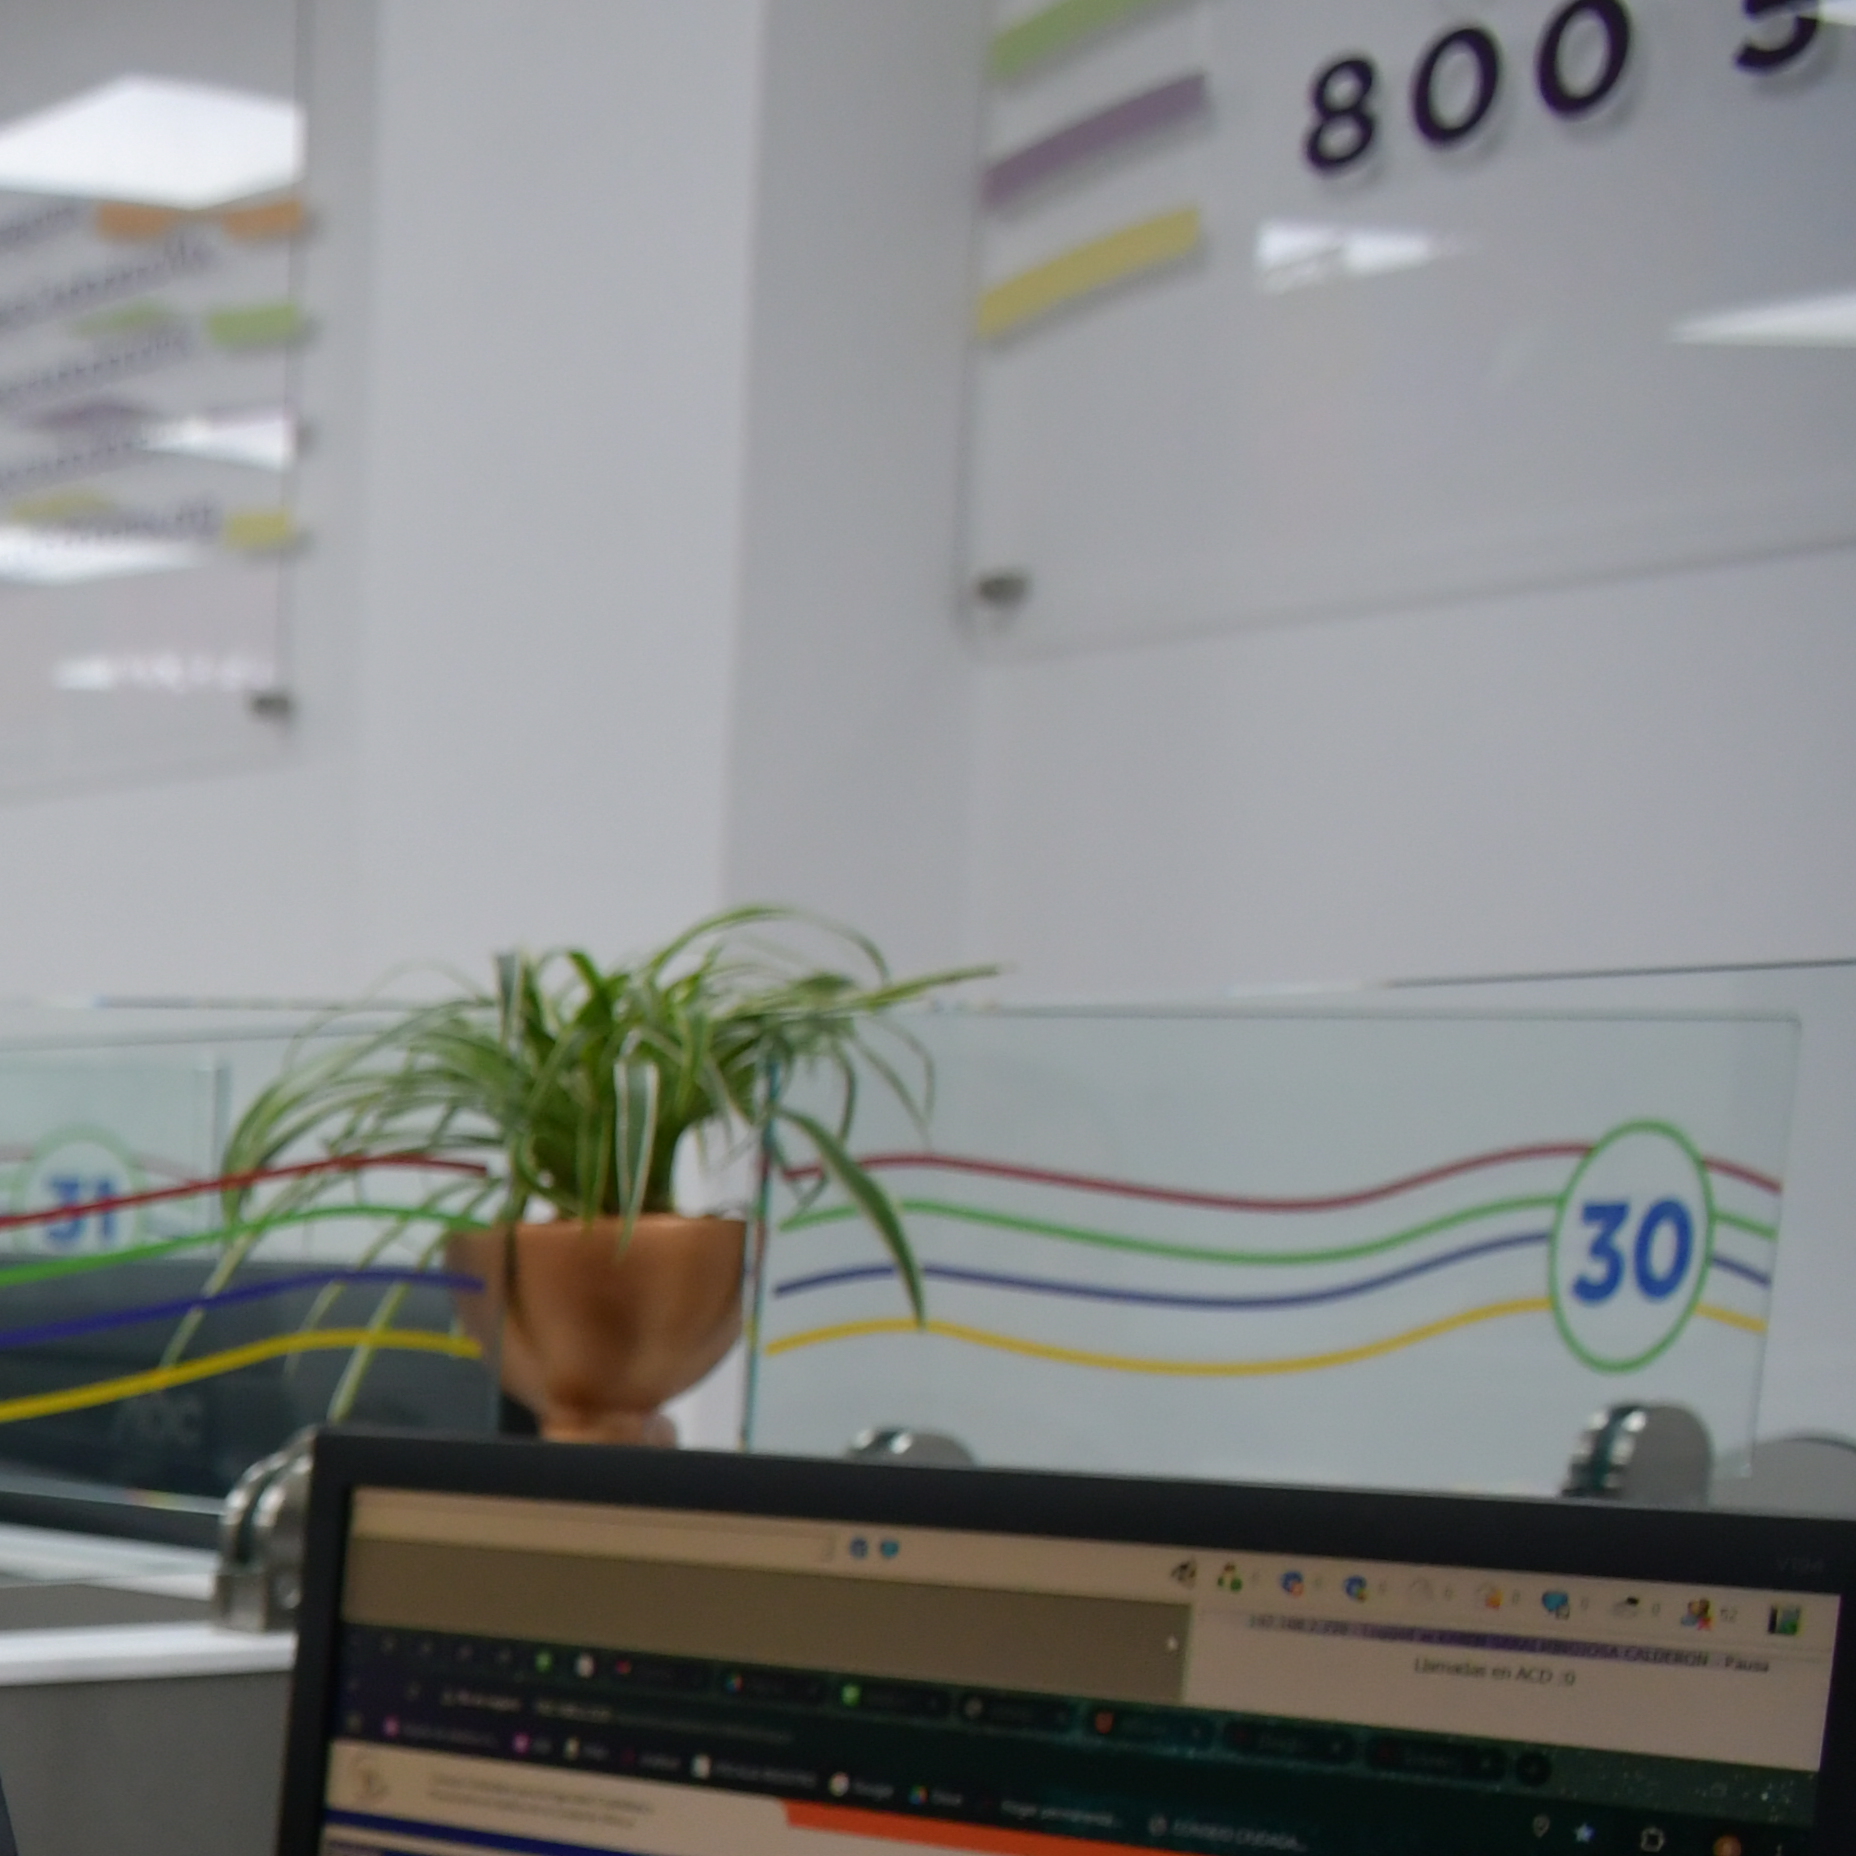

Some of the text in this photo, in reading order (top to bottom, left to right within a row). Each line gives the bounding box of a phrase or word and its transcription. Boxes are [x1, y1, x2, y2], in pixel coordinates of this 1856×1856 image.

[1304, 0, 1634, 174] 800
[44, 1172, 120, 1248] 31
[1572, 1197, 1694, 1306] 30
